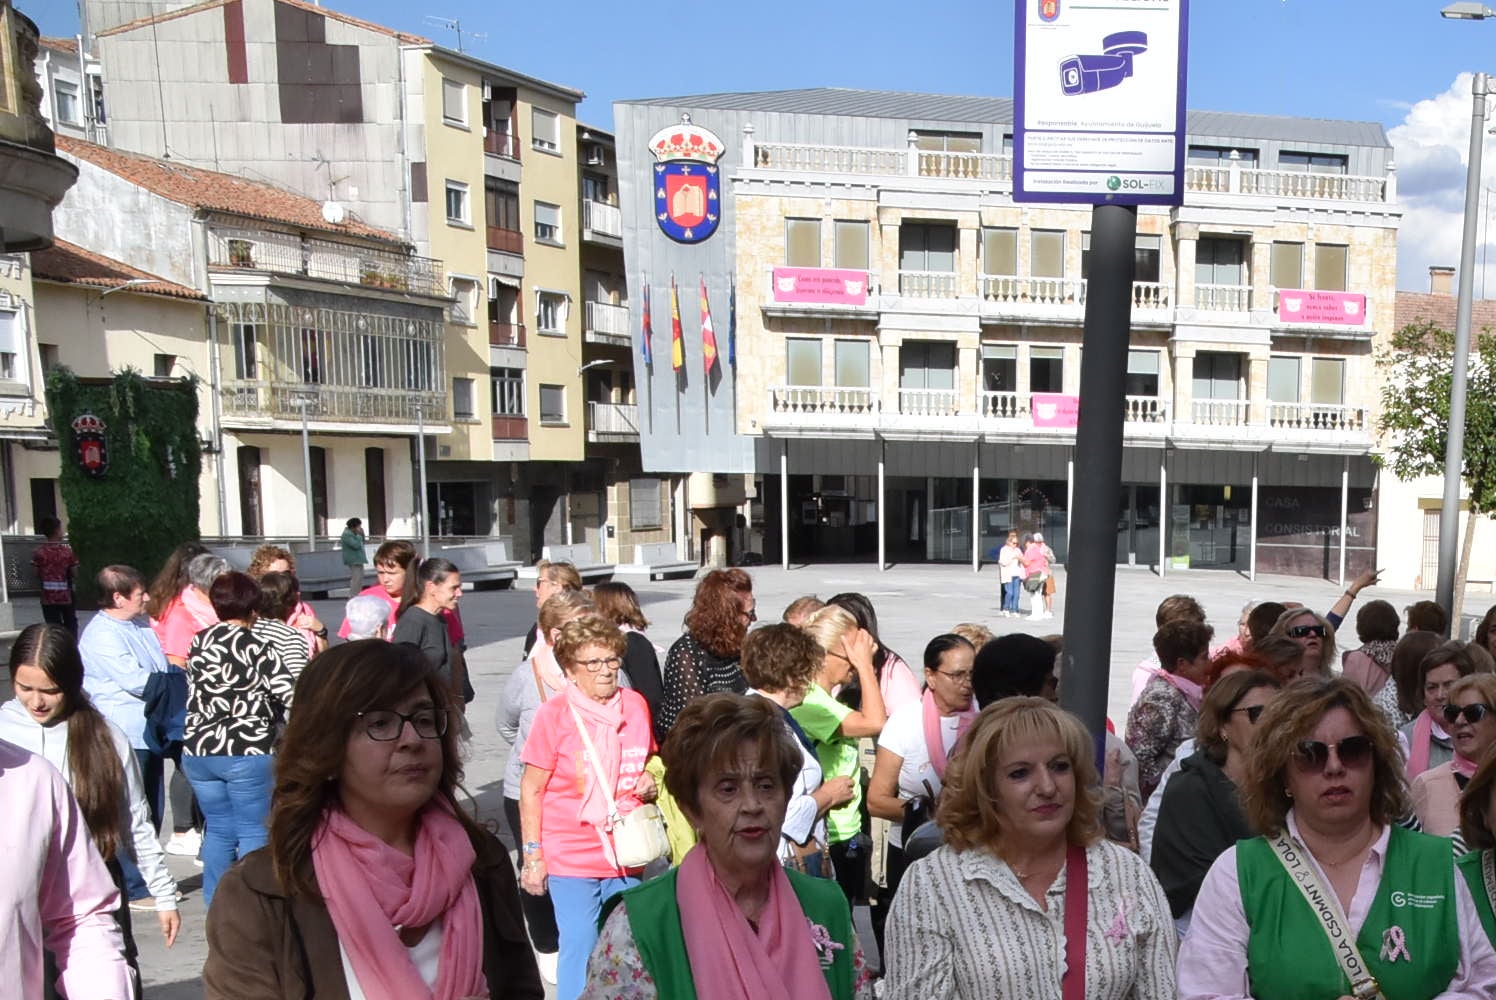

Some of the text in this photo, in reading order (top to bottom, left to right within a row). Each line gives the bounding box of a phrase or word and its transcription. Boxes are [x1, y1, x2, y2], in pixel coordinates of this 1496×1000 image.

[1264, 522, 1360, 537] CONSISTORAL
[1303, 882, 1343, 939] CSDMNT
[1339, 938, 1363, 978] LOLA
